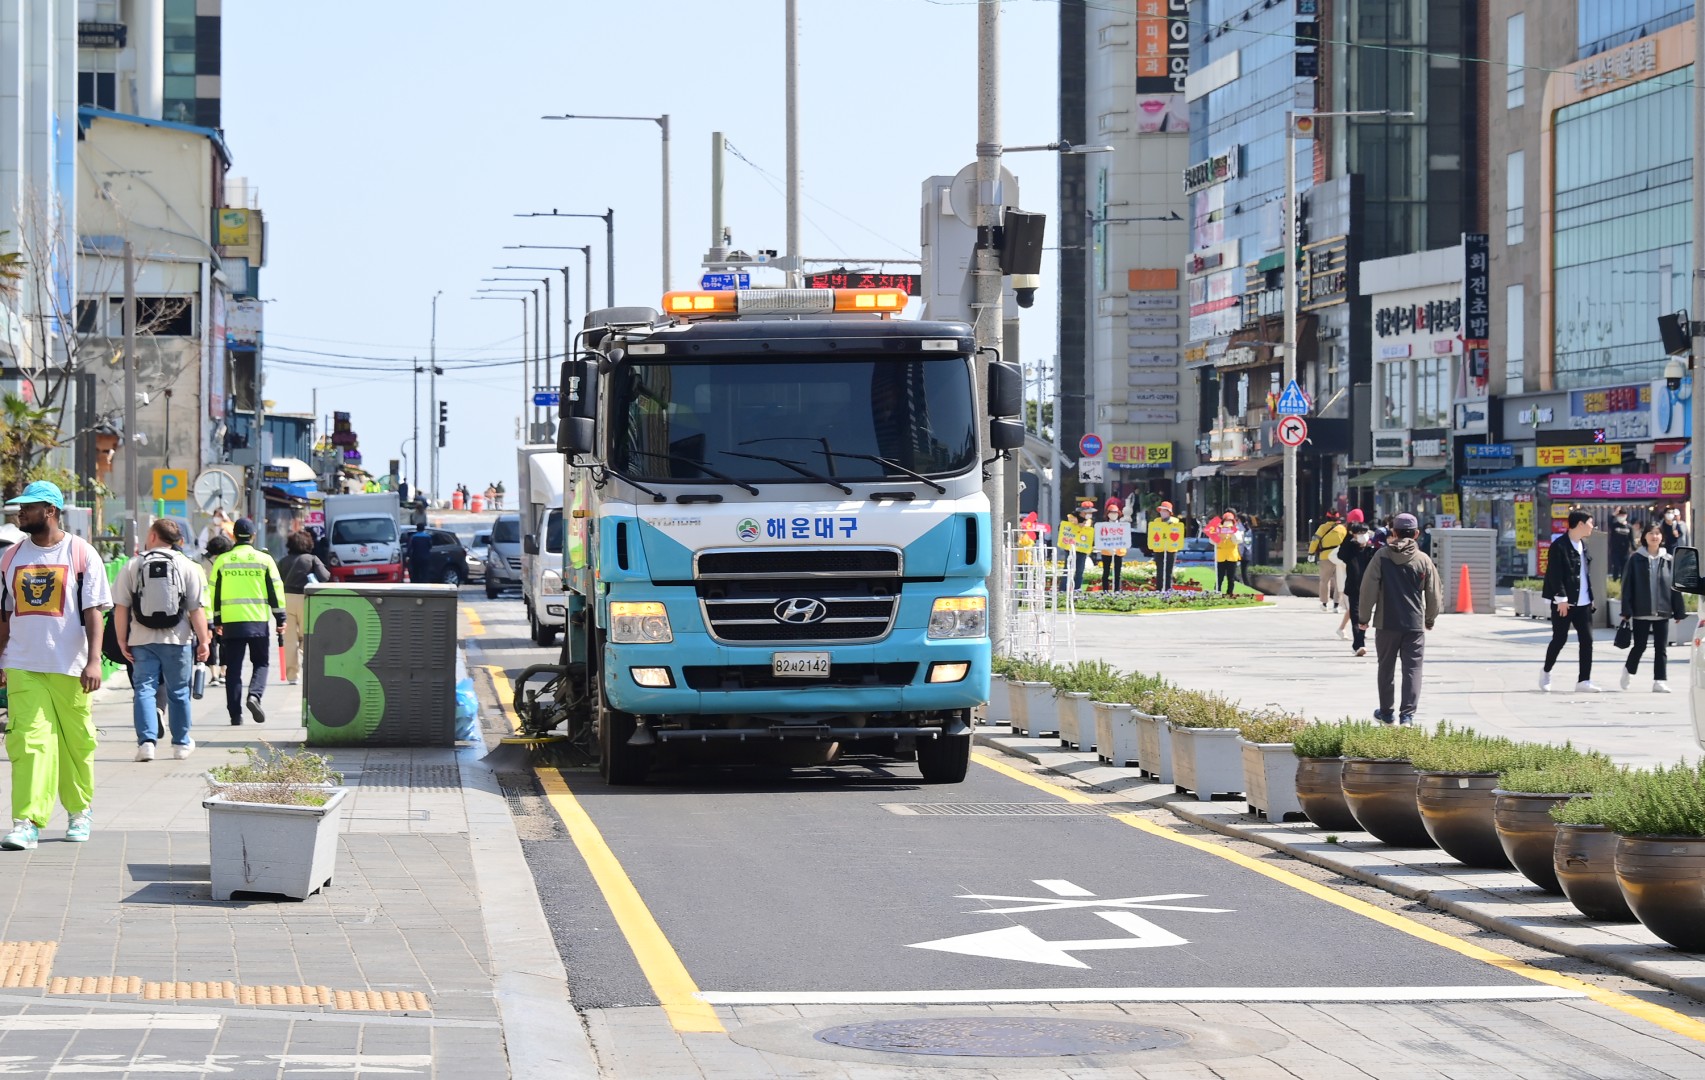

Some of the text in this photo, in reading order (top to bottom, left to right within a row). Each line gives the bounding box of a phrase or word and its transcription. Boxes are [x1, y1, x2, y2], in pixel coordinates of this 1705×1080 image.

[1470, 252, 1489, 337] 회전초밥
[1112, 446, 1168, 461] 임대 문의
[1538, 449, 1565, 464] 황금
[1568, 446, 1607, 459] 조개구이
[161, 475, 178, 495] P
[766, 517, 858, 539] 해운대구
[303, 588, 386, 746] 3
[775, 659, 827, 672] 82서2142
